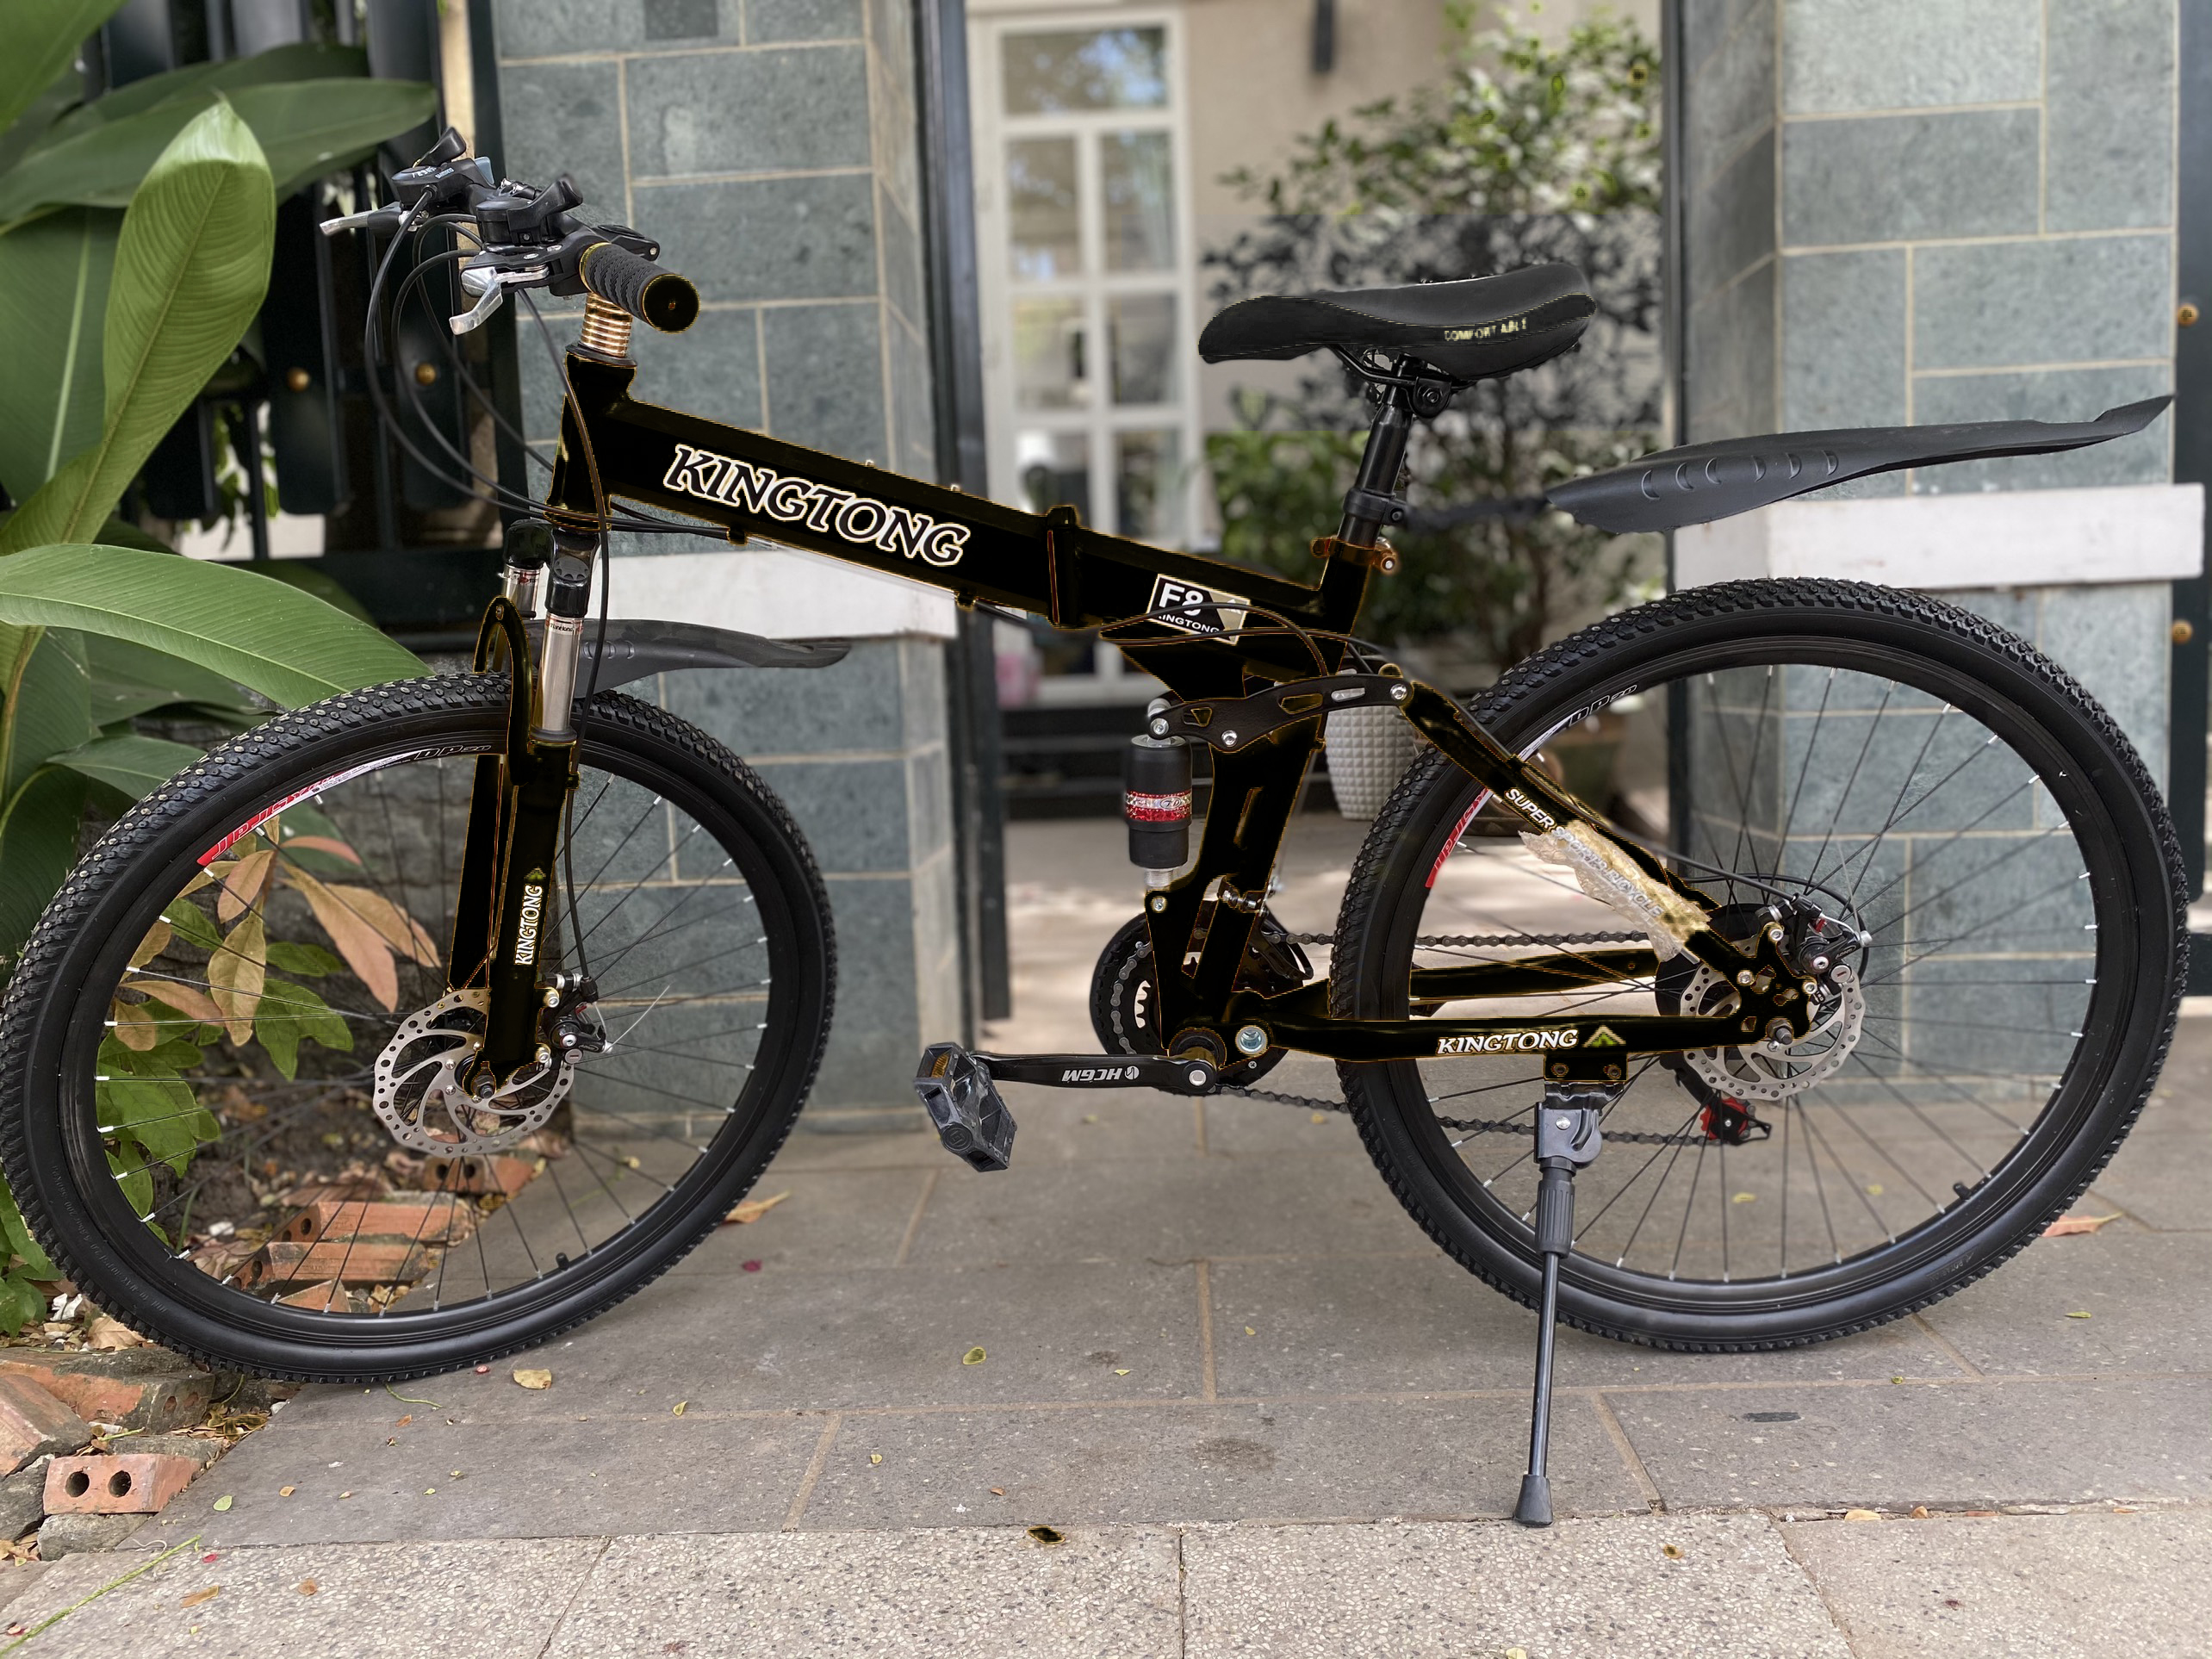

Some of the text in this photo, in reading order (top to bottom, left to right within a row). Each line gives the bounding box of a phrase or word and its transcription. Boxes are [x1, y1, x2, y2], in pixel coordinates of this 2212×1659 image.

[663, 444, 971, 566] KINGTONG
[1159, 582, 1204, 616] F8
[1159, 613, 1220, 634] INGTONG
[1505, 788, 1555, 830] SUPER
[515, 885, 543, 965] KINGTONG
[1437, 1029, 1579, 1055] KINGTONG
[1061, 1067, 1123, 1082] HCGM
